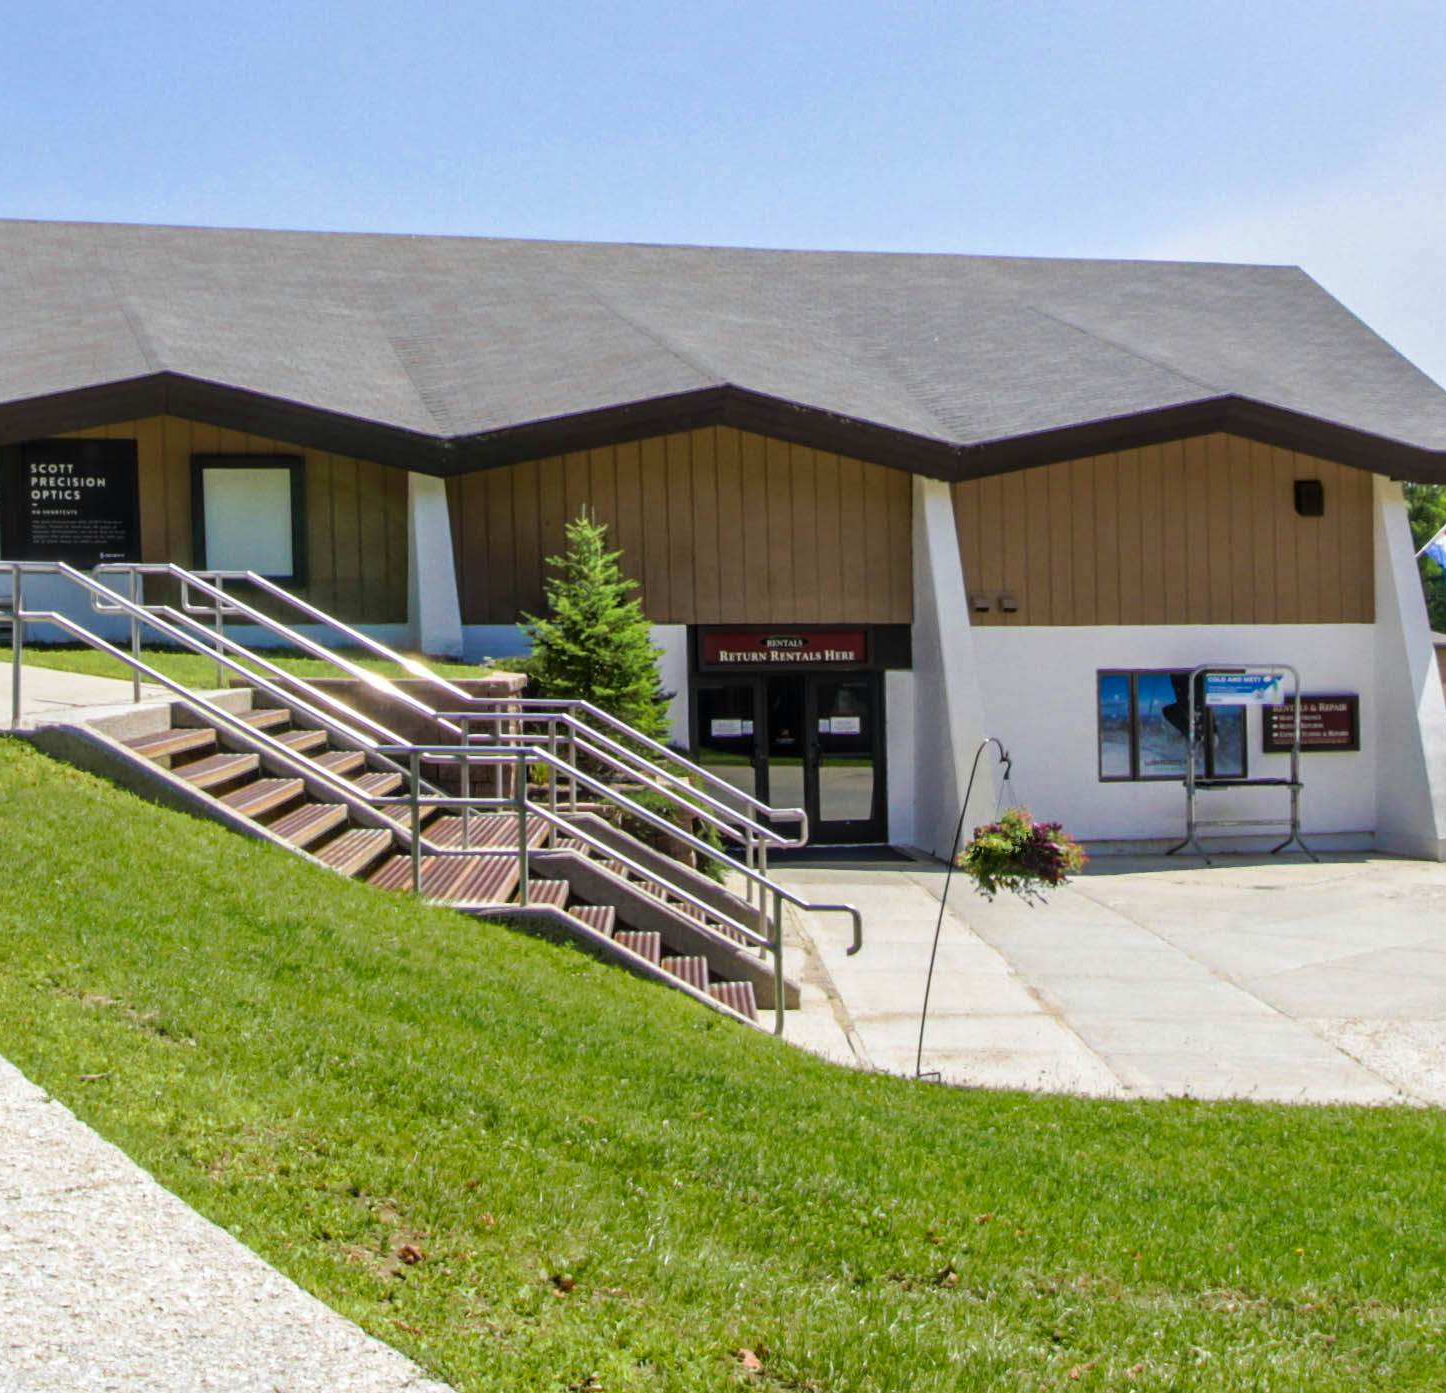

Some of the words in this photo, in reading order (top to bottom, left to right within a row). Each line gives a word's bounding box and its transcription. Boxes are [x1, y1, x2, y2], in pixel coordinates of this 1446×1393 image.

[30, 463, 74, 474] SCOTT
[30, 477, 106, 488] PRECISION
[30, 490, 81, 500] OPTICS
[766, 639, 804, 648] RENTALS
[719, 650, 768, 662] RETURN
[770, 650, 822, 662] RENTALS
[824, 649, 856, 661] HERE
